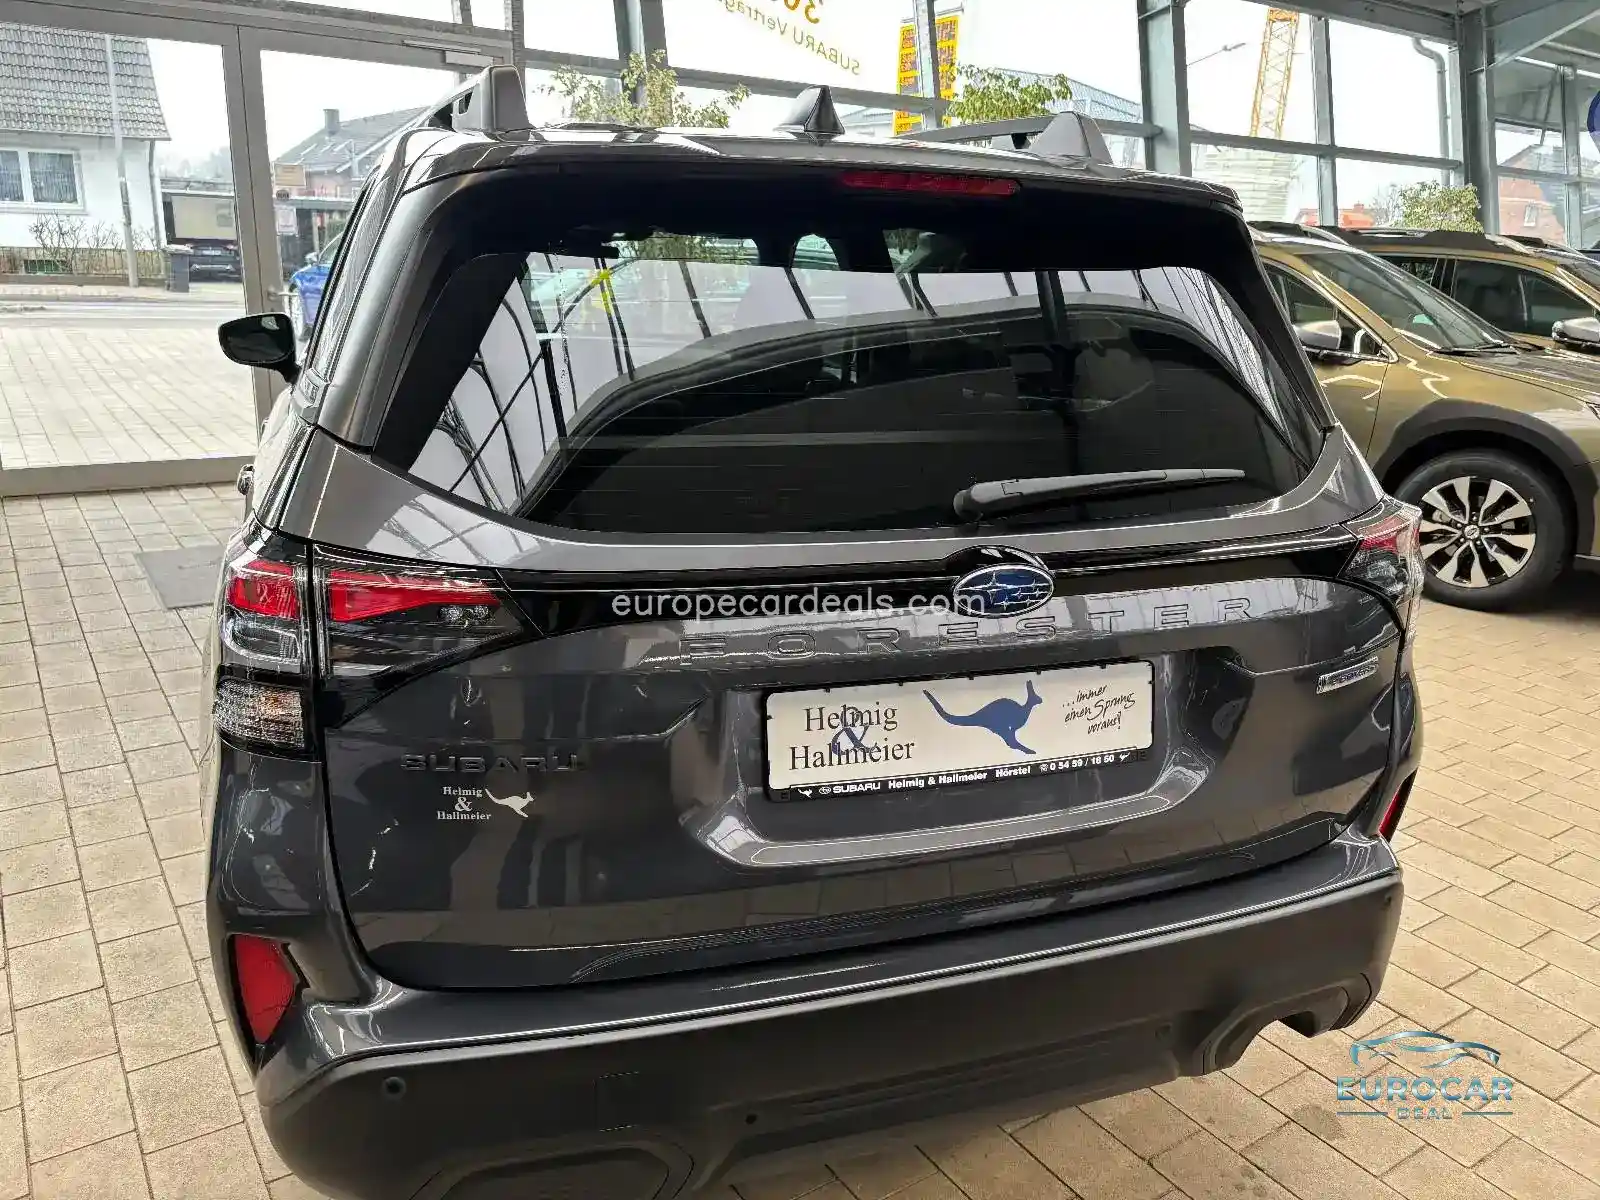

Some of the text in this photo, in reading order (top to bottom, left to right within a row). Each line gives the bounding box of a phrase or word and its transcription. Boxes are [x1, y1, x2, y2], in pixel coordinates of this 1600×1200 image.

[679, 596, 1253, 667] FORESTER
[802, 701, 898, 732] Helmig
[1064, 692, 1136, 723] einen Sprung
[831, 704, 877, 756] &
[400, 754, 577, 773] SUBARU
[789, 737, 915, 770] Hallmeier
[442, 786, 483, 798] Helmig
[832, 782, 881, 794] SUBARU
[888, 778, 925, 790] Helmig
[927, 776, 936, 786] &
[938, 770, 988, 785] Hallmeier
[995, 765, 1031, 778] Hörstel
[1049, 762, 1056, 771] 0
[1058, 760, 1070, 769] 54
[436, 810, 492, 820] Hallmeier
[454, 796, 473, 812] &
